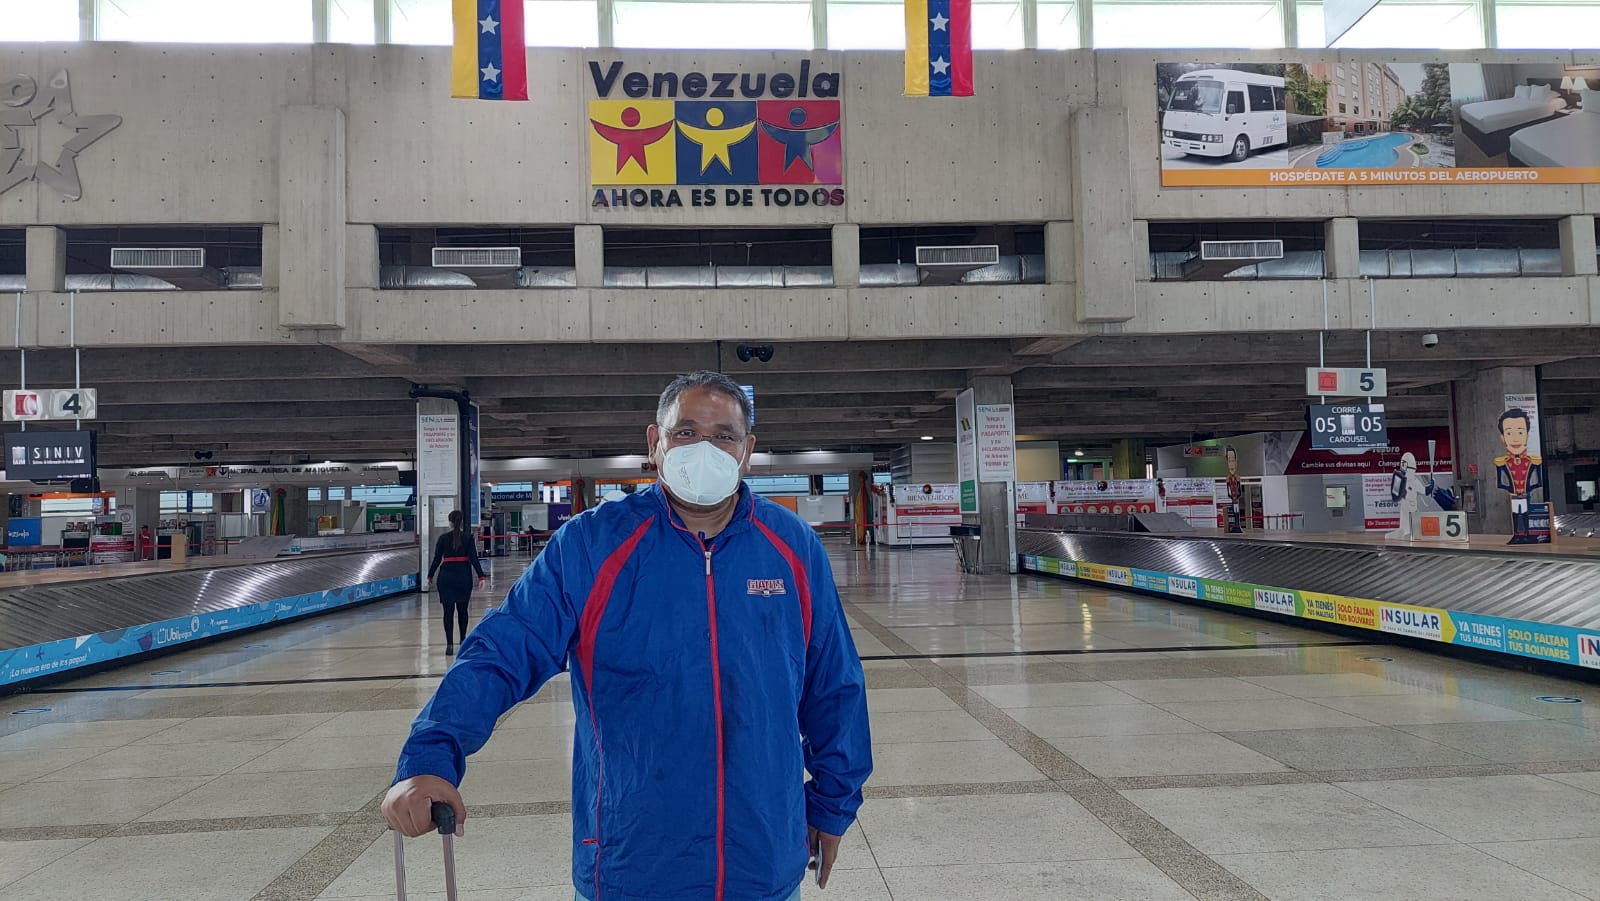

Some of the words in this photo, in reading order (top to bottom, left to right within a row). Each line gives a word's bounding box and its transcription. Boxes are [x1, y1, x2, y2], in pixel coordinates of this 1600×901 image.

[588, 59, 840, 99] Venezuela
[1269, 170, 1346, 181] HOSPÉDATE
[1348, 171, 1358, 180] A
[1359, 171, 1368, 180] 5
[1370, 171, 1427, 180] MINUTOS
[1428, 171, 1452, 180] DEL
[1455, 170, 1539, 180] AEROPUERTO
[592, 189, 683, 207] AHORA
[691, 189, 716, 207] ES
[725, 189, 753, 207] DE
[761, 189, 845, 207] TODOS
[1359, 372, 1375, 391] 5
[63, 393, 81, 414] 4
[1315, 417, 1337, 432] 05
[1360, 416, 1382, 432] 05
[33, 446, 82, 459] SINIV
[1446, 515, 1461, 537] 5
[1107, 570, 1127, 579] INSULAR
[1169, 578, 1195, 590] INSULAR
[1256, 590, 1294, 607] INSULAR
[1307, 600, 1313, 608] YA
[1315, 600, 1333, 611] TIENES
[1338, 603, 1352, 613] SOLO
[1354, 606, 1375, 616] FALTAN
[1338, 613, 1347, 621] TUS
[1348, 615, 1375, 627] BOLIVARES
[1381, 608, 1440, 630] INSULAR
[1458, 621, 1469, 633] YA
[1471, 623, 1500, 637] TIENES
[1460, 633, 1471, 642] TUS
[1472, 635, 1501, 647] MALETAS
[1508, 628, 1531, 641] SOLO
[1534, 633, 1568, 647] FALTAN
[1509, 641, 1523, 652] TUS
[1525, 644, 1570, 660] BOLIVARES
[20, 664, 39, 674] nueva
